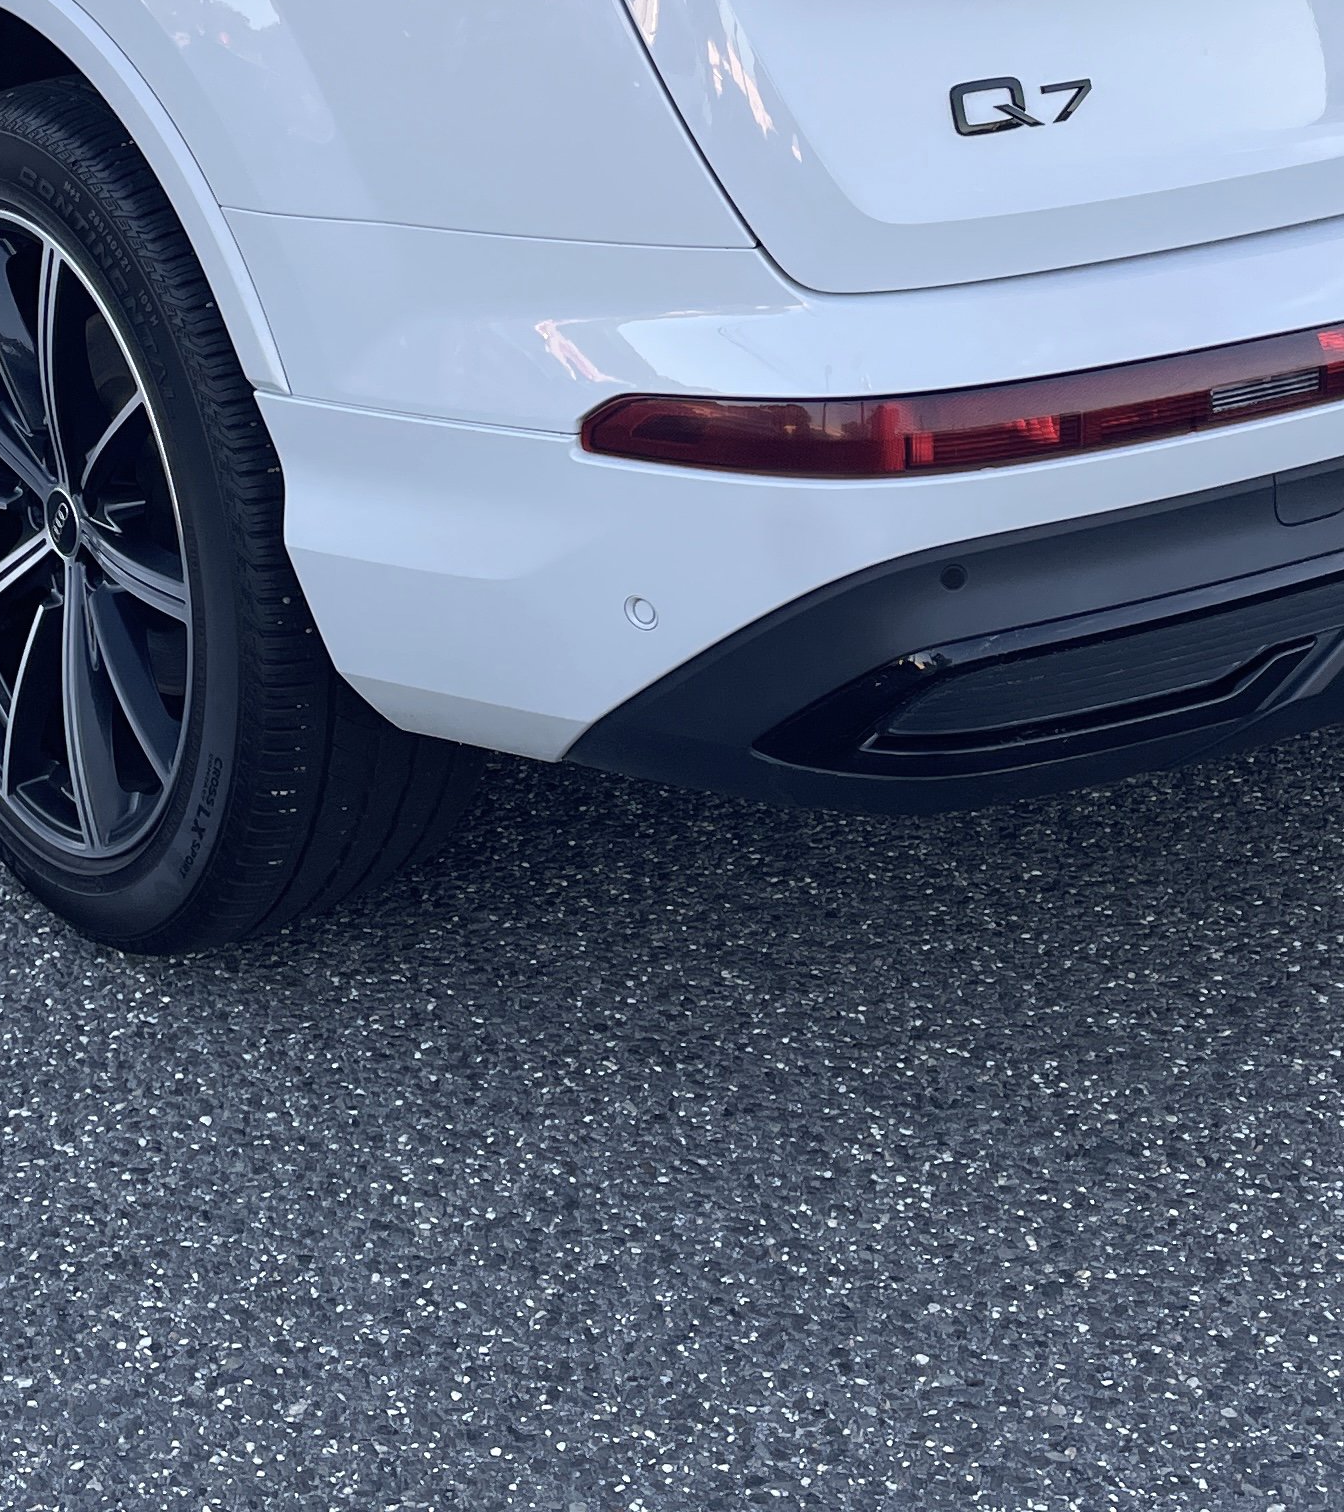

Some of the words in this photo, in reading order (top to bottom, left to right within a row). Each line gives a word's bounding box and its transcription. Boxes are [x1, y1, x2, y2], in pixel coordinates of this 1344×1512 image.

[949, 76, 1093, 137] Q7
[18, 166, 177, 400] CONTINENTAL
[206, 756, 223, 808] CROSS
[191, 804, 212, 841] LX
[179, 839, 201, 880] SPORT
